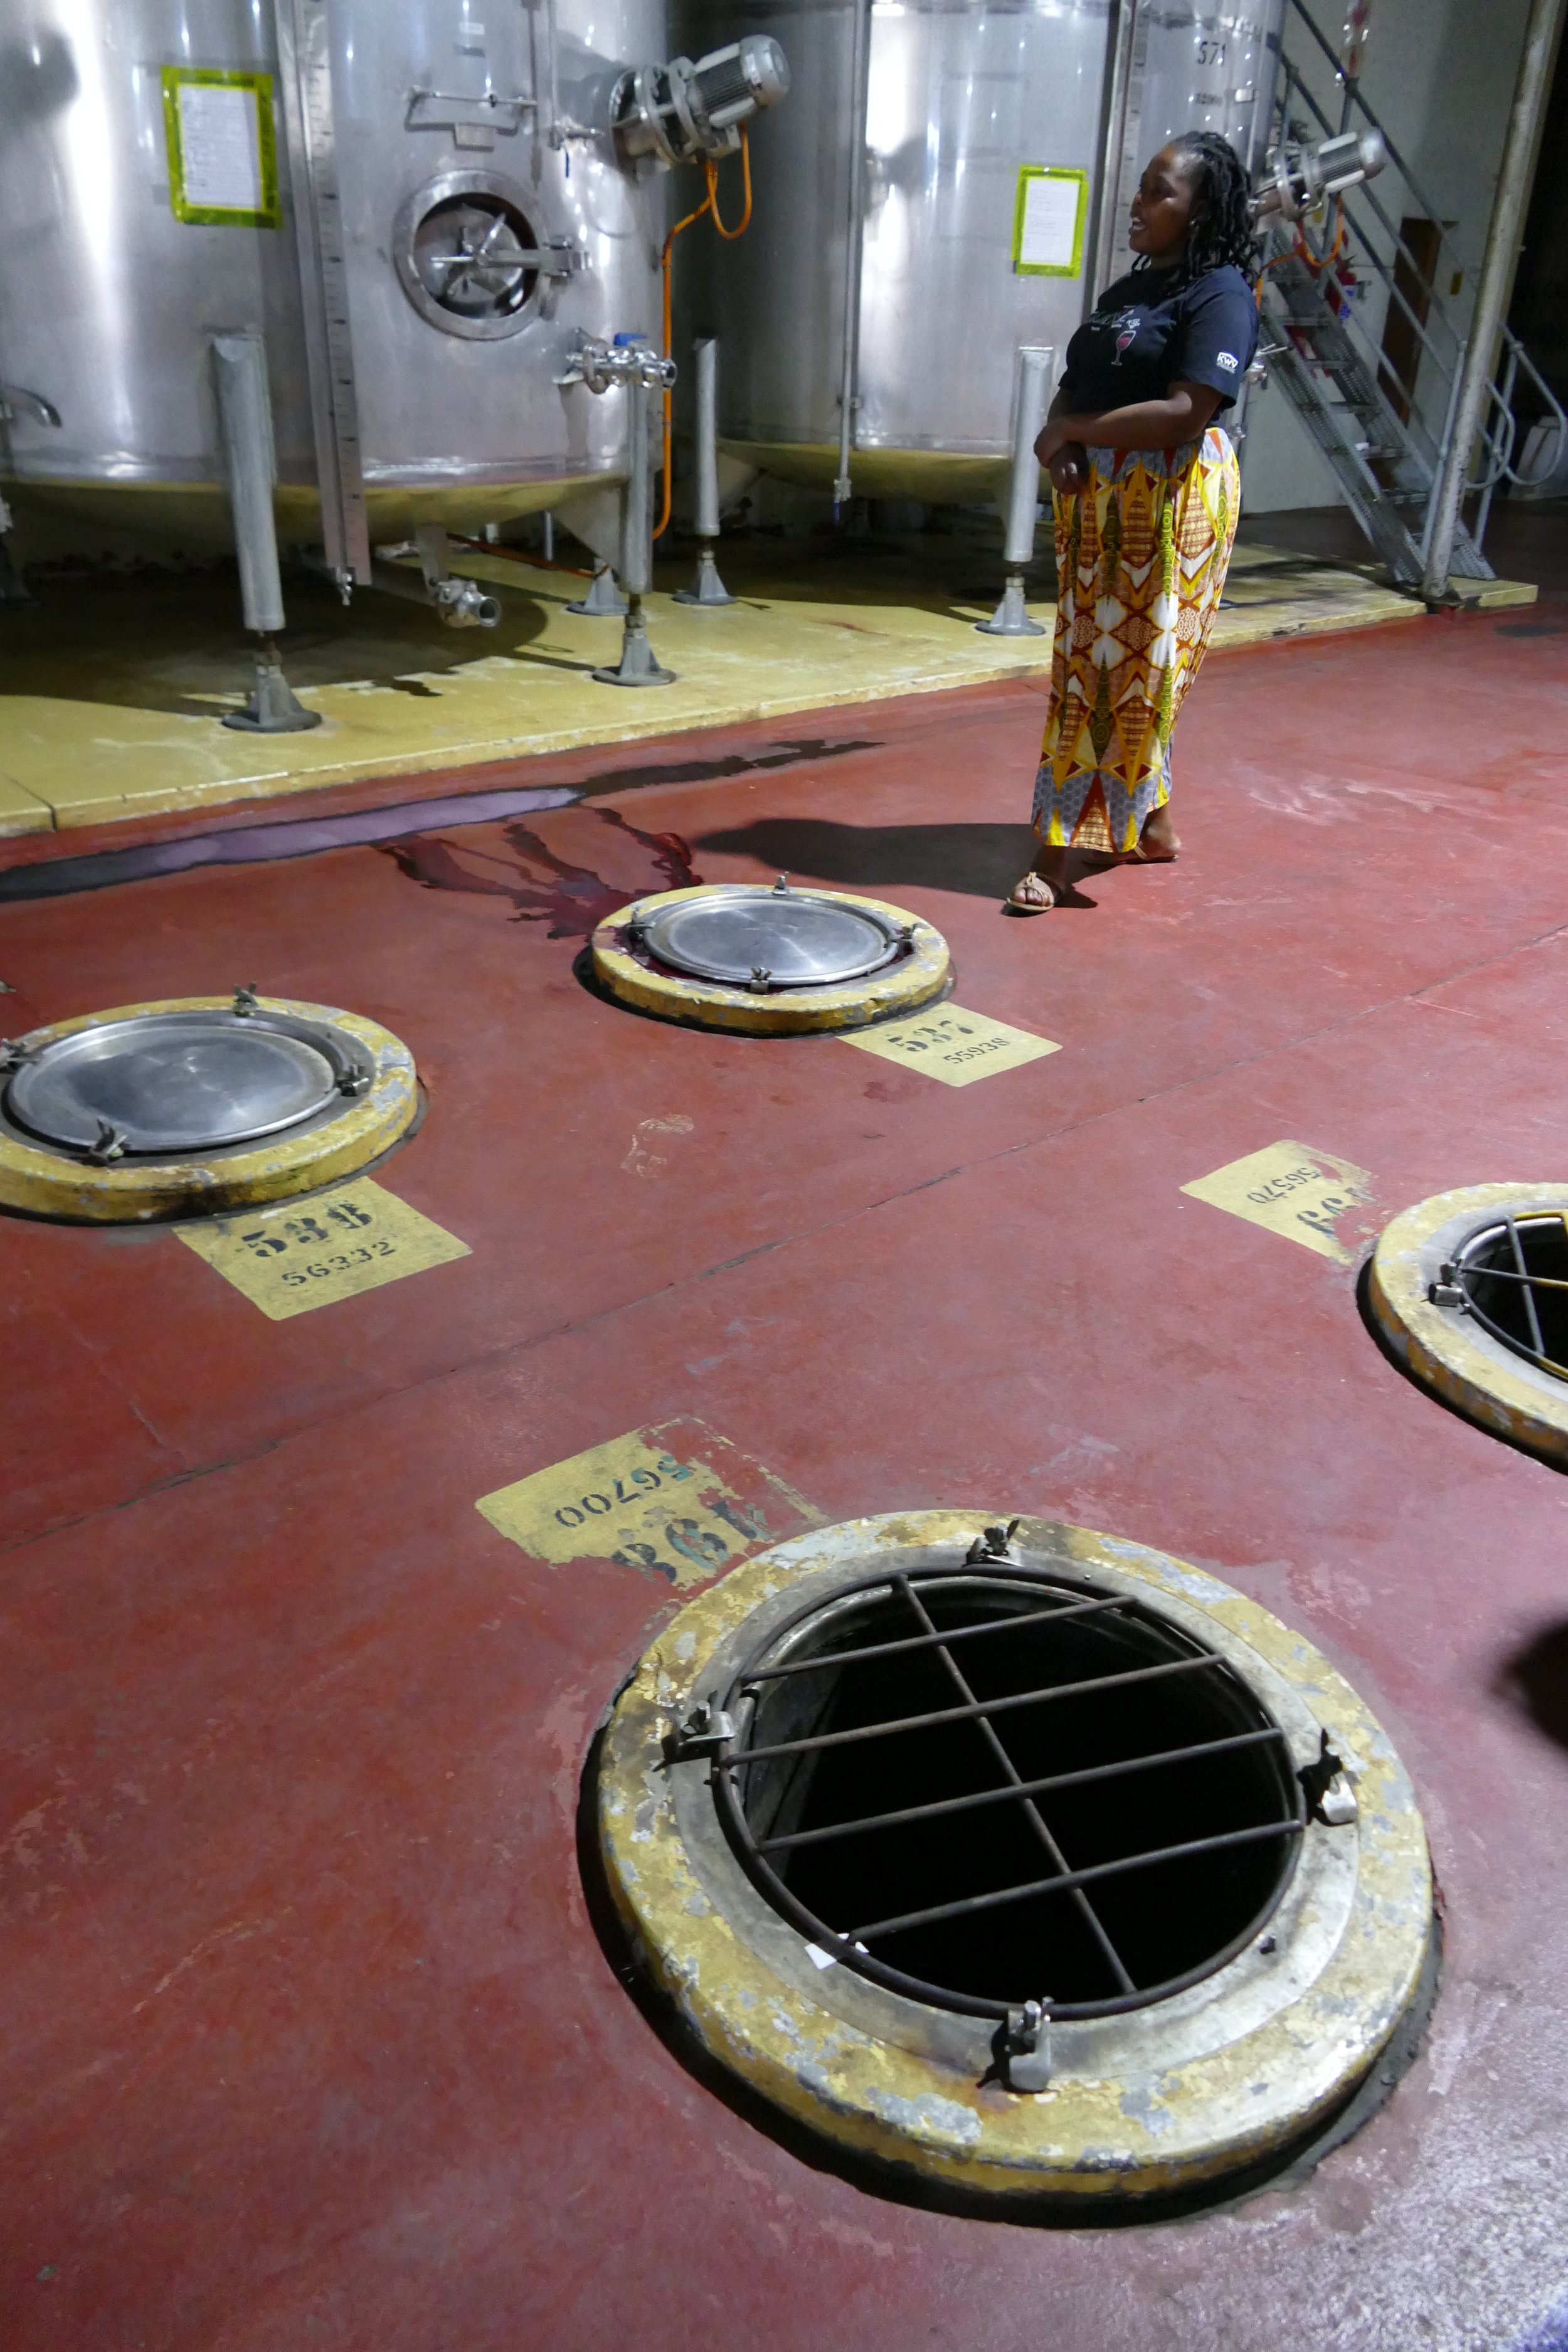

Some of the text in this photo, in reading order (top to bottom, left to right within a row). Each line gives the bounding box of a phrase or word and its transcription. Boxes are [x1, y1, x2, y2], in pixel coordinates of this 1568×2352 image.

[1217, 352, 1239, 369] KWV
[943, 1038, 1010, 1064] 55938
[282, 1241, 397, 1286] 56332
[554, 1454, 693, 1528] 56700
